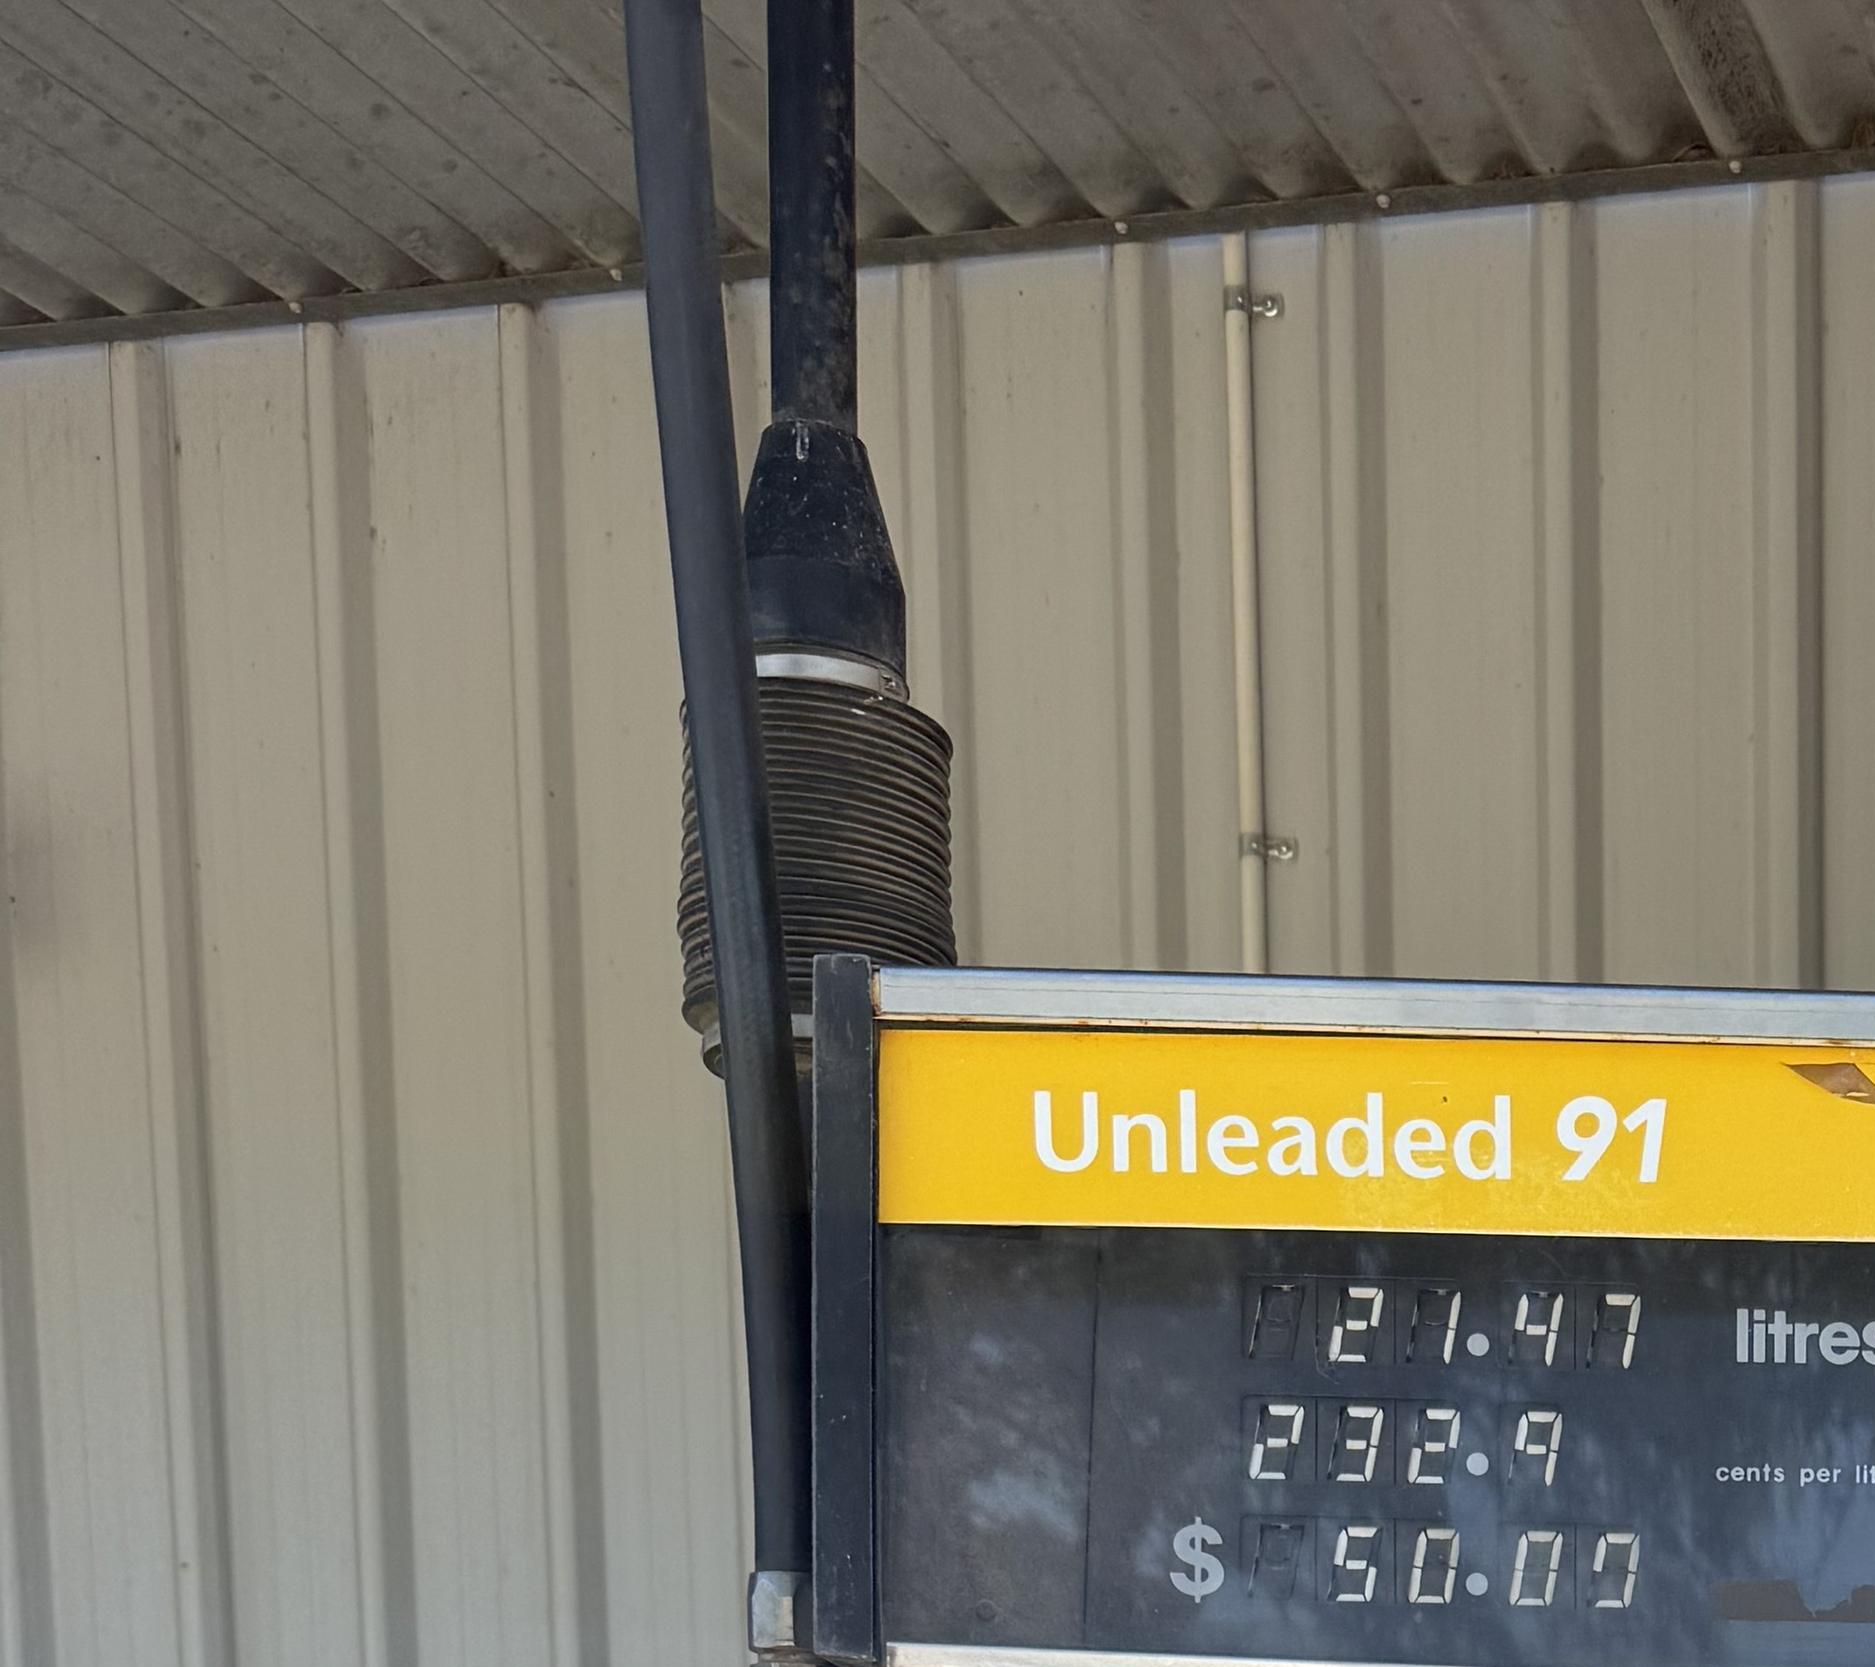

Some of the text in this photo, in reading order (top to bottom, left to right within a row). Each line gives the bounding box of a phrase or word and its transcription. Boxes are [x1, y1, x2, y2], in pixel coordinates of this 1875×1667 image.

[1034, 1089, 1667, 1184] Unleaded 91
[1329, 1287, 1641, 1369] 21.47
[1249, 1405, 1563, 1486] 232.9
[1715, 1463, 1786, 1483] cents
[1799, 1466, 1842, 1488] per
